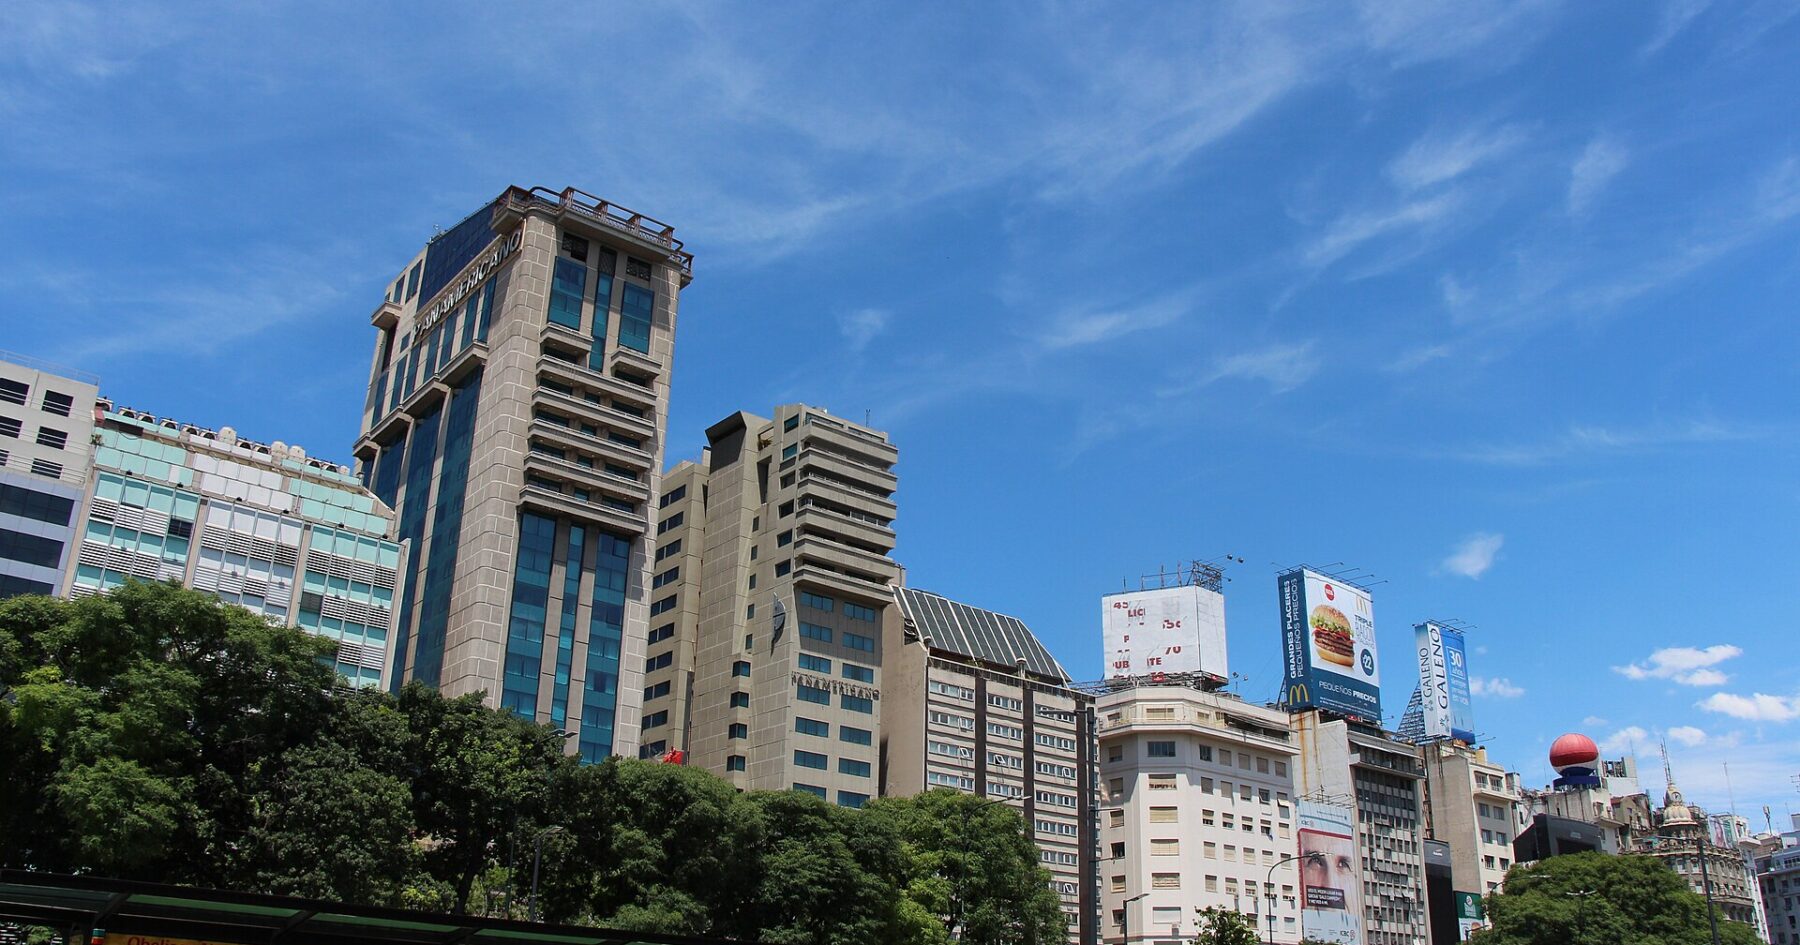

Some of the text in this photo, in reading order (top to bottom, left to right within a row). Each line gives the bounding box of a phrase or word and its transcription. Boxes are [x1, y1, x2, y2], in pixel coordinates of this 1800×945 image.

[412, 229, 521, 339] PANAMERICANO
[1290, 578, 1300, 621] PRECIOS
[1354, 614, 1374, 628] TRIPLE
[1284, 580, 1297, 679] GRANDES PLACERES
[1420, 648, 1432, 698] GALENO
[1430, 628, 1448, 709] GALENO
[1450, 651, 1461, 667] 30
[1318, 680, 1377, 704] PEQUEÑOS PRECIOS
